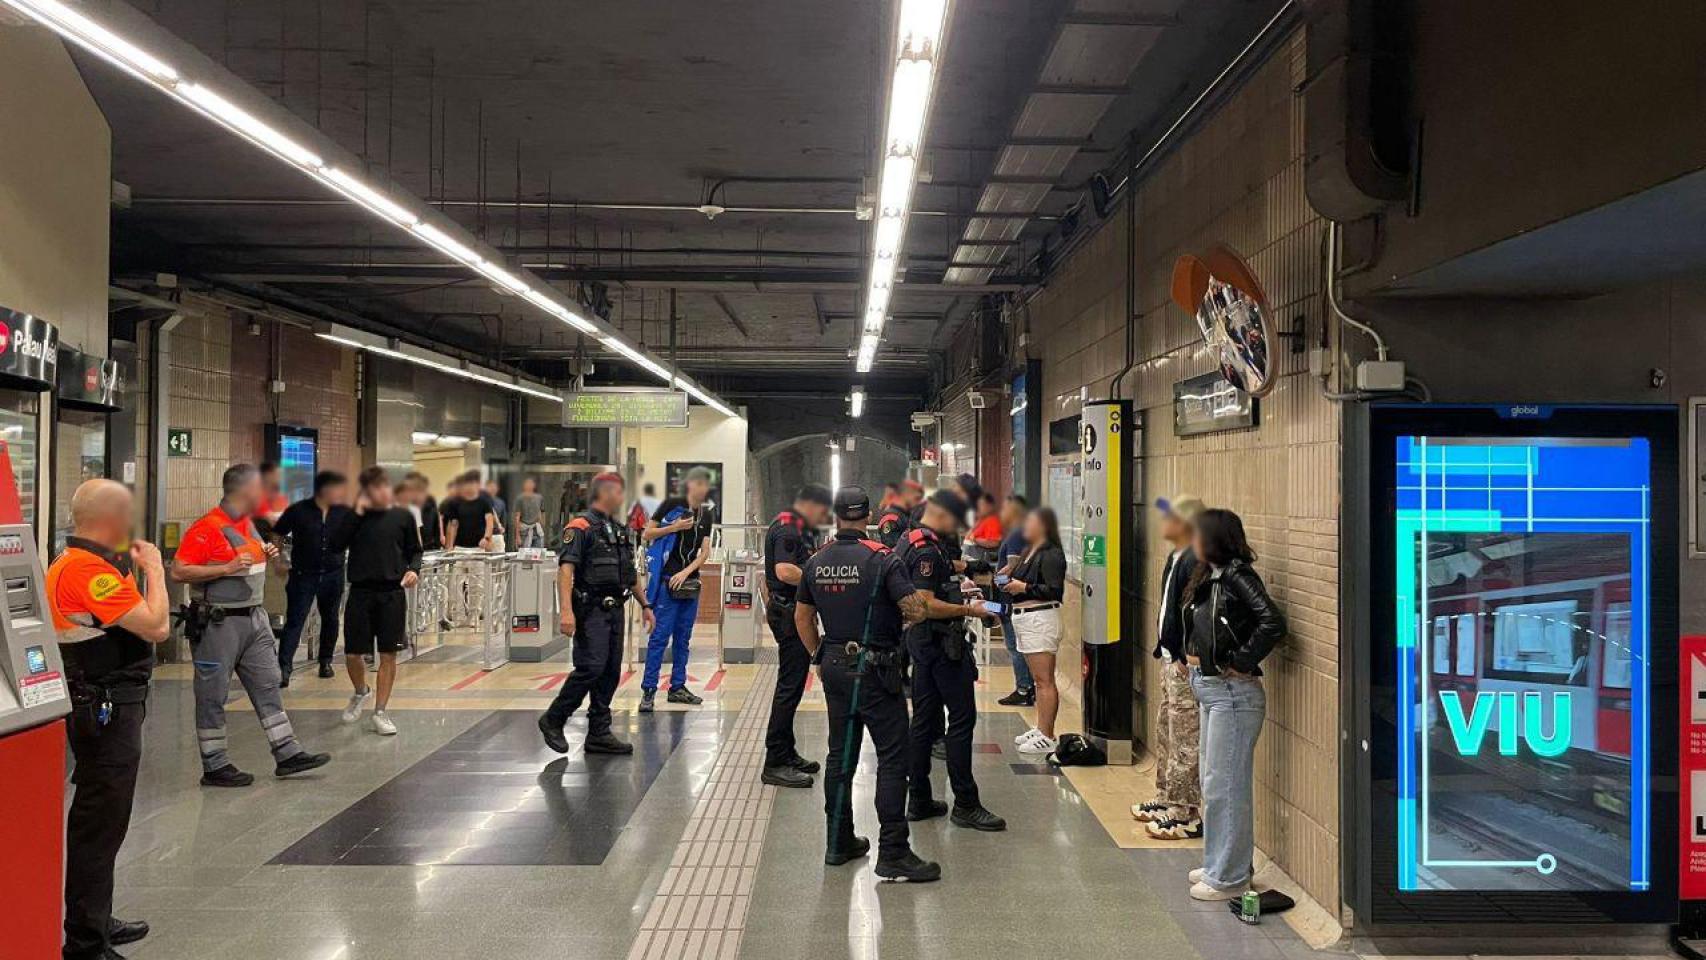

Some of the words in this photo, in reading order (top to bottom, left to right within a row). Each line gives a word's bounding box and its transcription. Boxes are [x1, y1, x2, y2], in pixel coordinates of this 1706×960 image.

[13, 329, 42, 359] Palau
[1511, 405, 1539, 417] global
[815, 565, 859, 577] POLICIA
[1439, 690, 1571, 756] VIU
